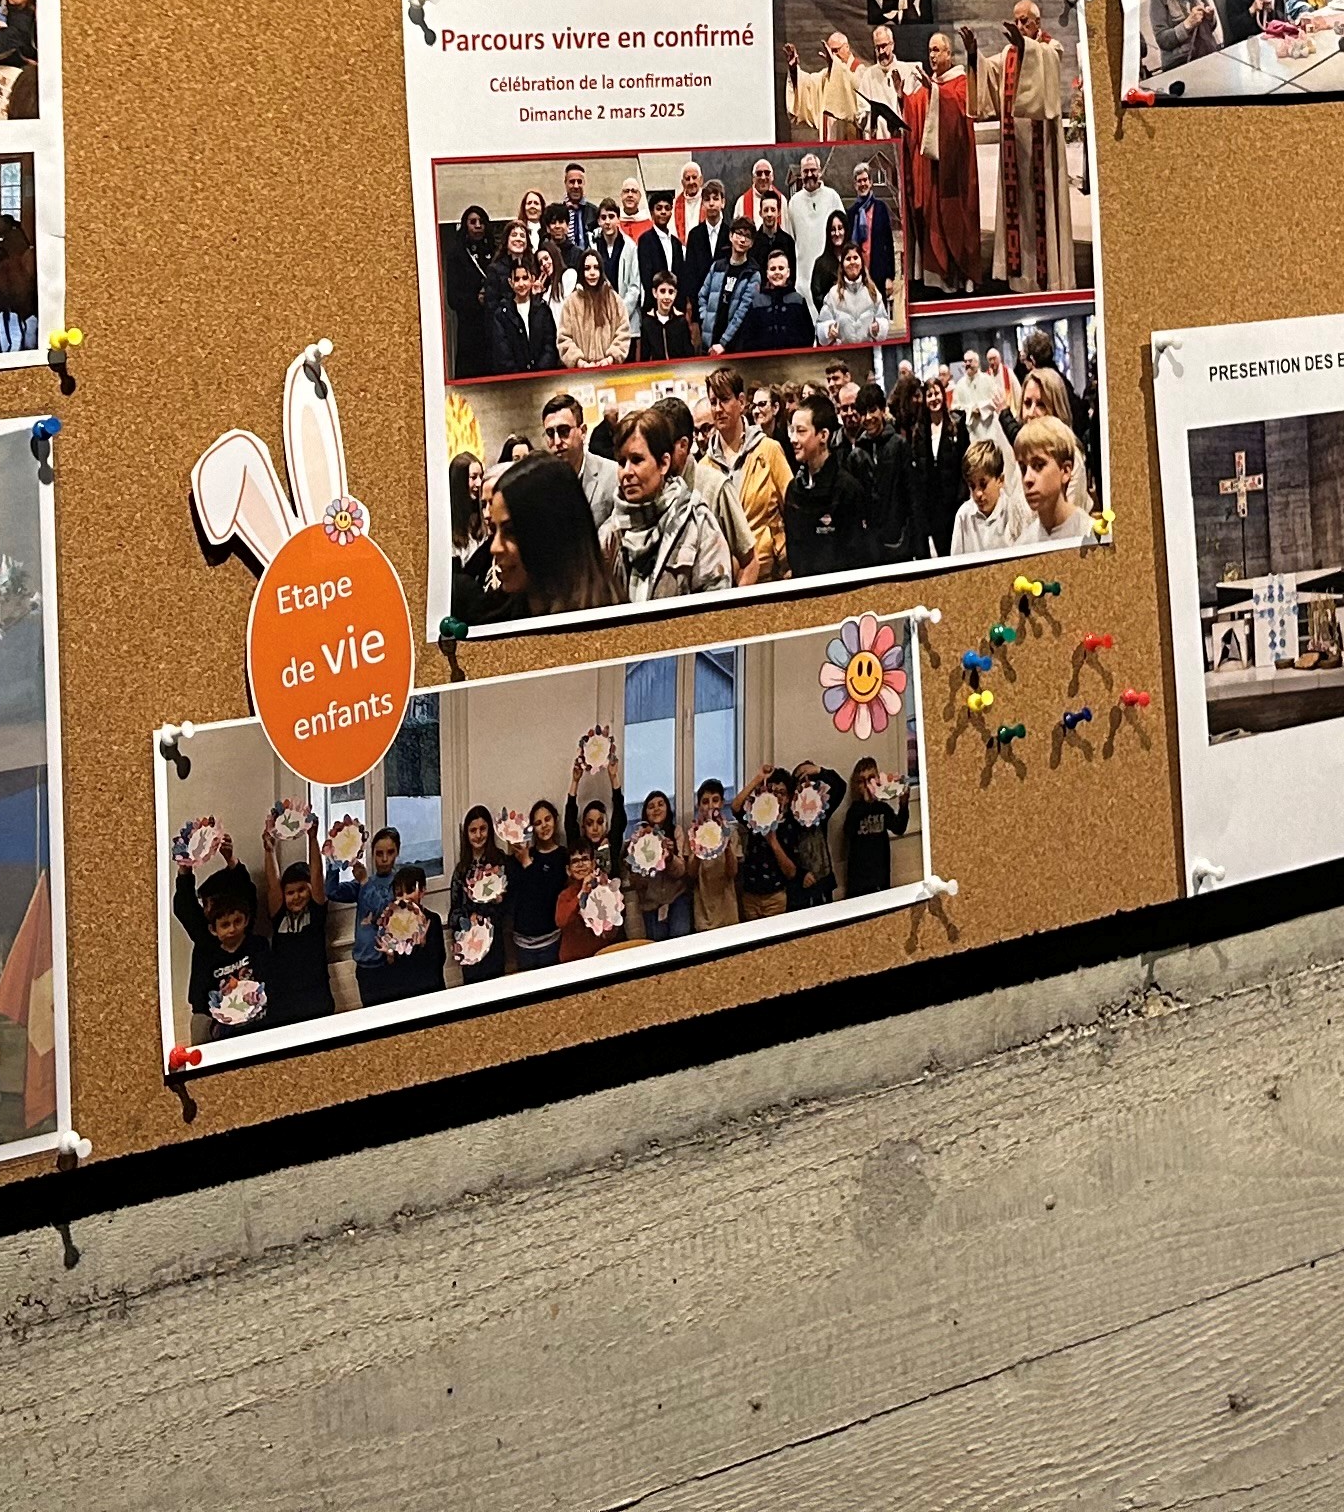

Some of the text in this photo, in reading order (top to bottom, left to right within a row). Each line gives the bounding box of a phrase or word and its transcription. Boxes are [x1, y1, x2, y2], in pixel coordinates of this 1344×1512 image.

[440, 22, 755, 52] Parcours vivre en confirmé
[489, 72, 713, 94] Célébration de la confirmation
[518, 102, 686, 122] Dimanche 2 mars 2025
[1208, 356, 1301, 383] PRESENTION
[1303, 352, 1334, 371] DES
[276, 575, 354, 615] Etape
[281, 624, 386, 688] de vie
[293, 692, 395, 740] enfants
